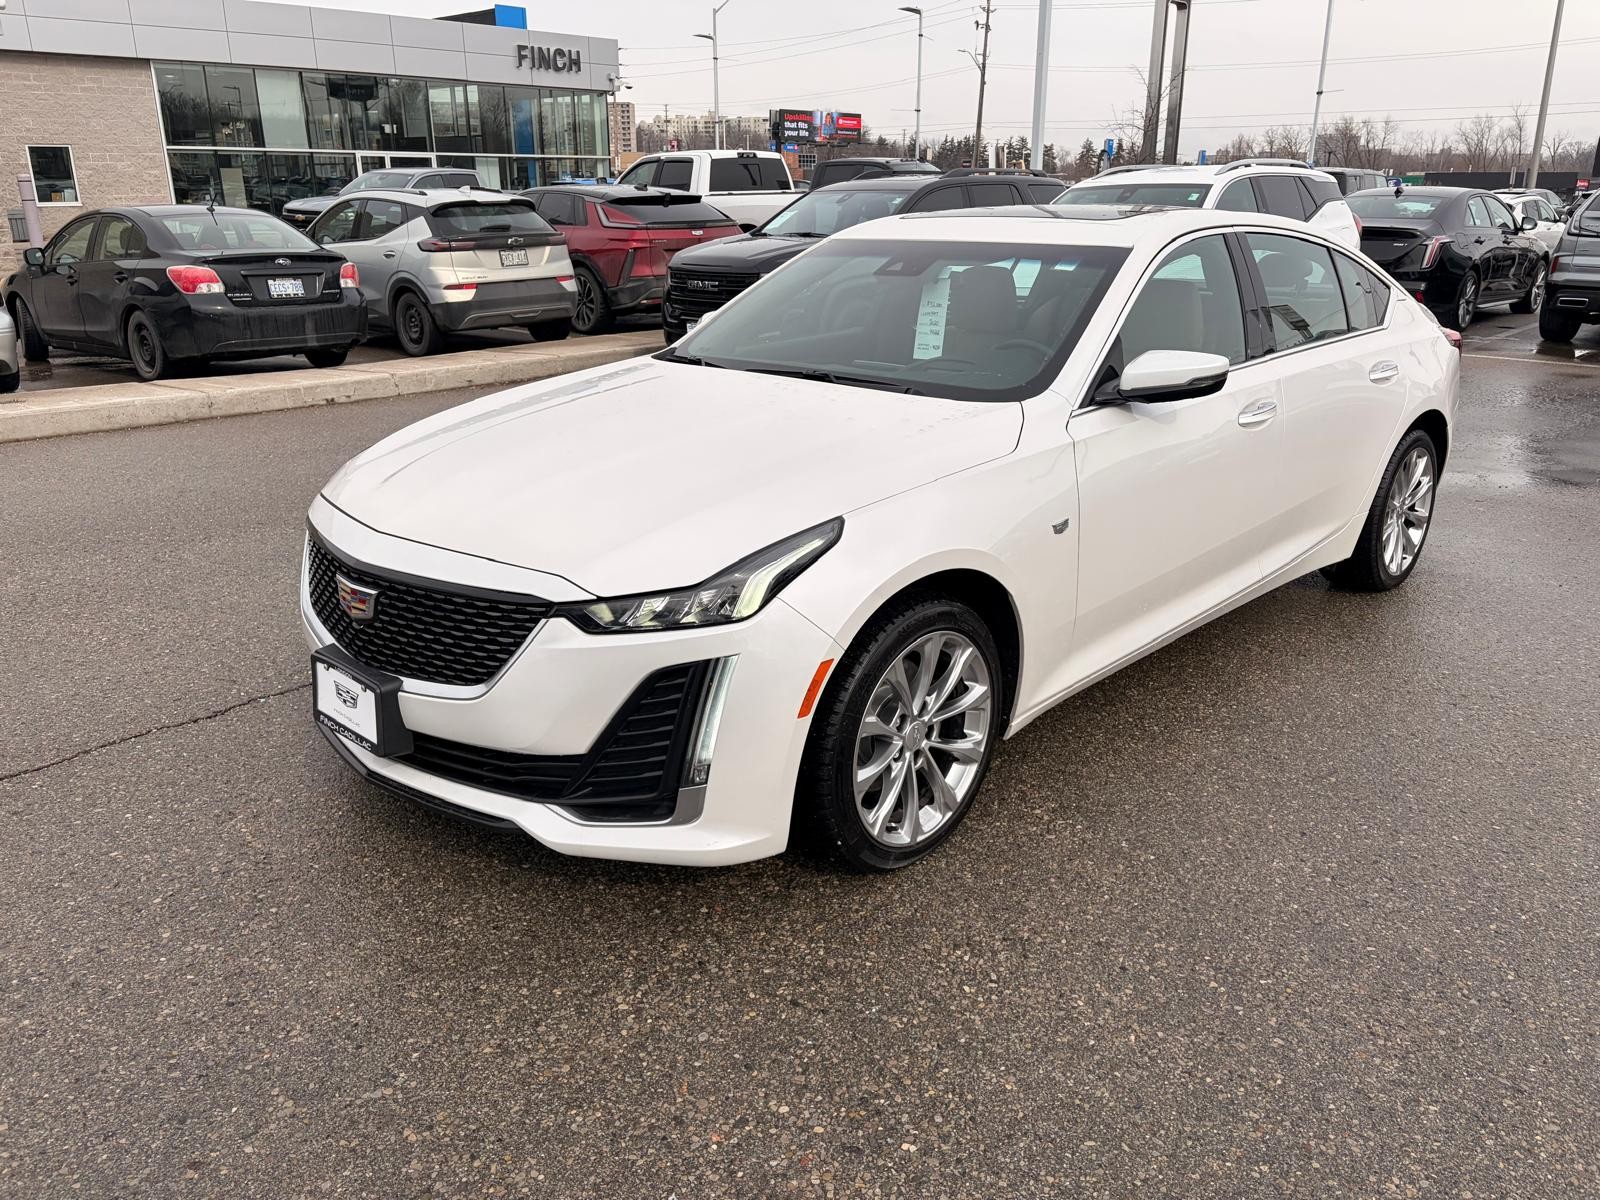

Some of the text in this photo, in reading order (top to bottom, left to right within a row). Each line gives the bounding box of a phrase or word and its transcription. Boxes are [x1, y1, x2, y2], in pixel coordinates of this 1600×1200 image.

[516, 44, 582, 73] FINCH
[784, 121, 808, 129] that fits
[687, 280, 719, 292] GMC
[320, 715, 339, 732] FINCH
[340, 728, 371, 750] CADILLAC
